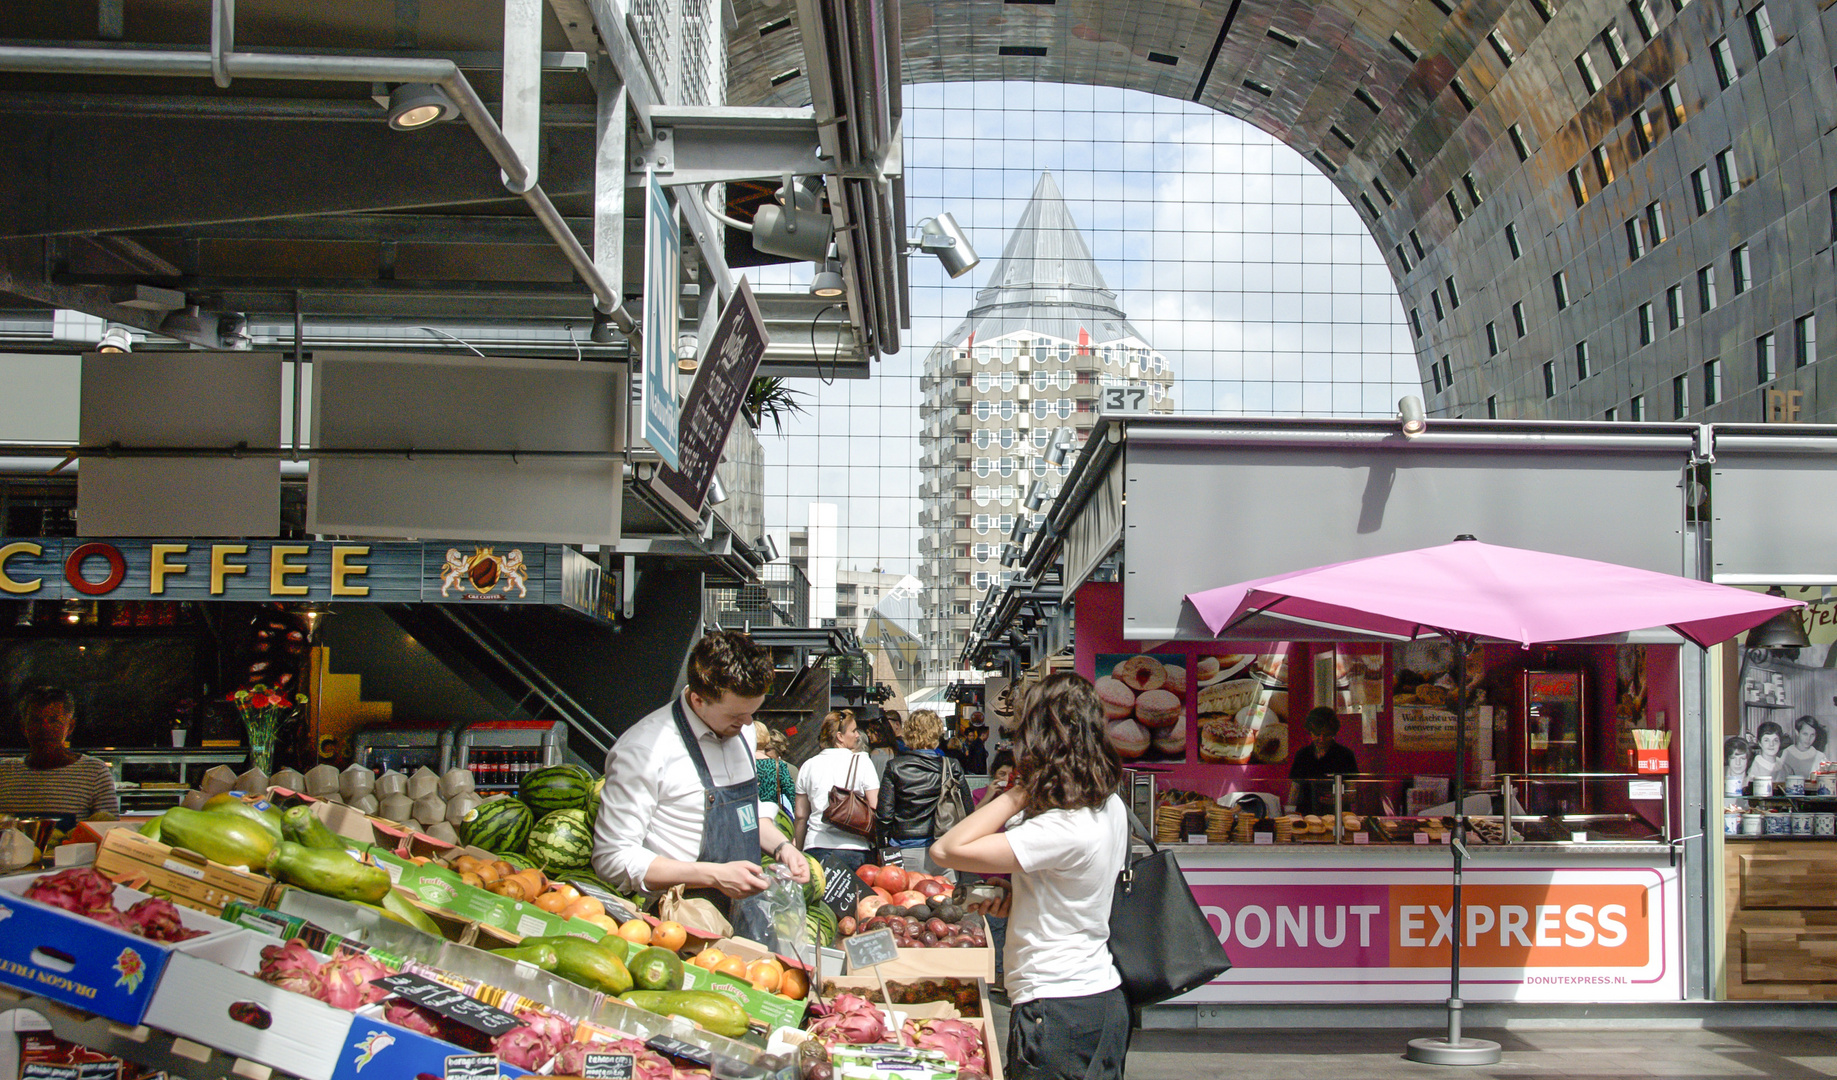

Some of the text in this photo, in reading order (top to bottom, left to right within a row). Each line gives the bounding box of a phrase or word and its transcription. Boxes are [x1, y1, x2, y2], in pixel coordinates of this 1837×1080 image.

[651, 209, 677, 403] N!
[1107, 389, 1145, 410] 37
[0, 542, 370, 595] COFFEE
[822, 619, 836, 627] 13
[1200, 904, 1628, 948] DONUT EXPRESS
[36, 970, 97, 999] DRAGON
[1527, 976, 1628, 984] DONUTEXPRESS.NL
